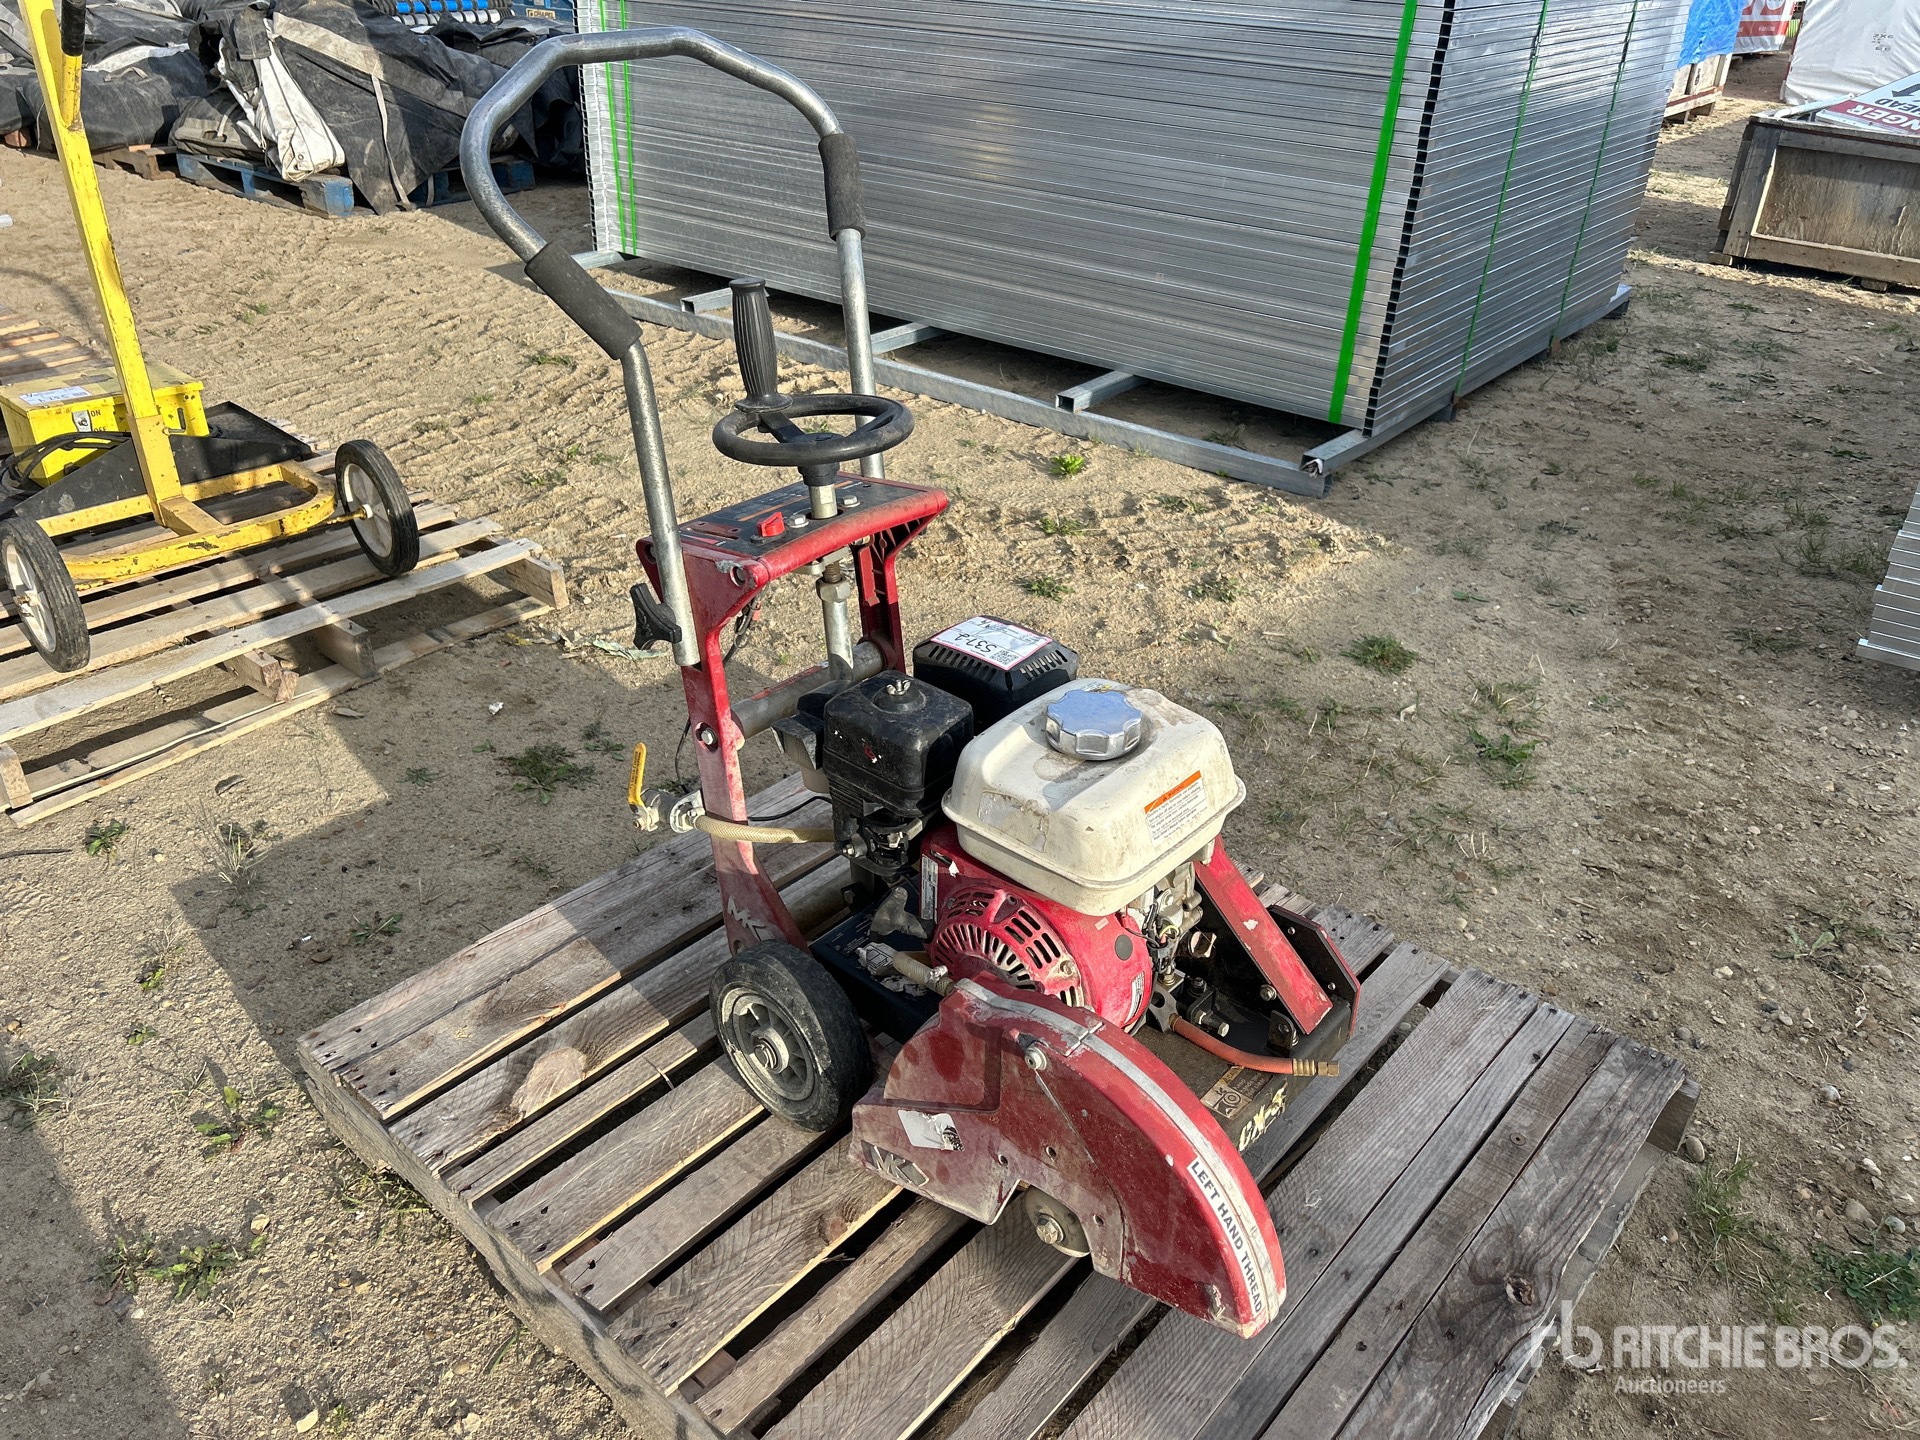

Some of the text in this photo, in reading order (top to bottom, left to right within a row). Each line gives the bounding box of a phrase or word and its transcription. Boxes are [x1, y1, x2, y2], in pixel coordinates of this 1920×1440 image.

[90, 409, 101, 417] ON
[1190, 1160, 1262, 1314] LEFT HAND THREAD
